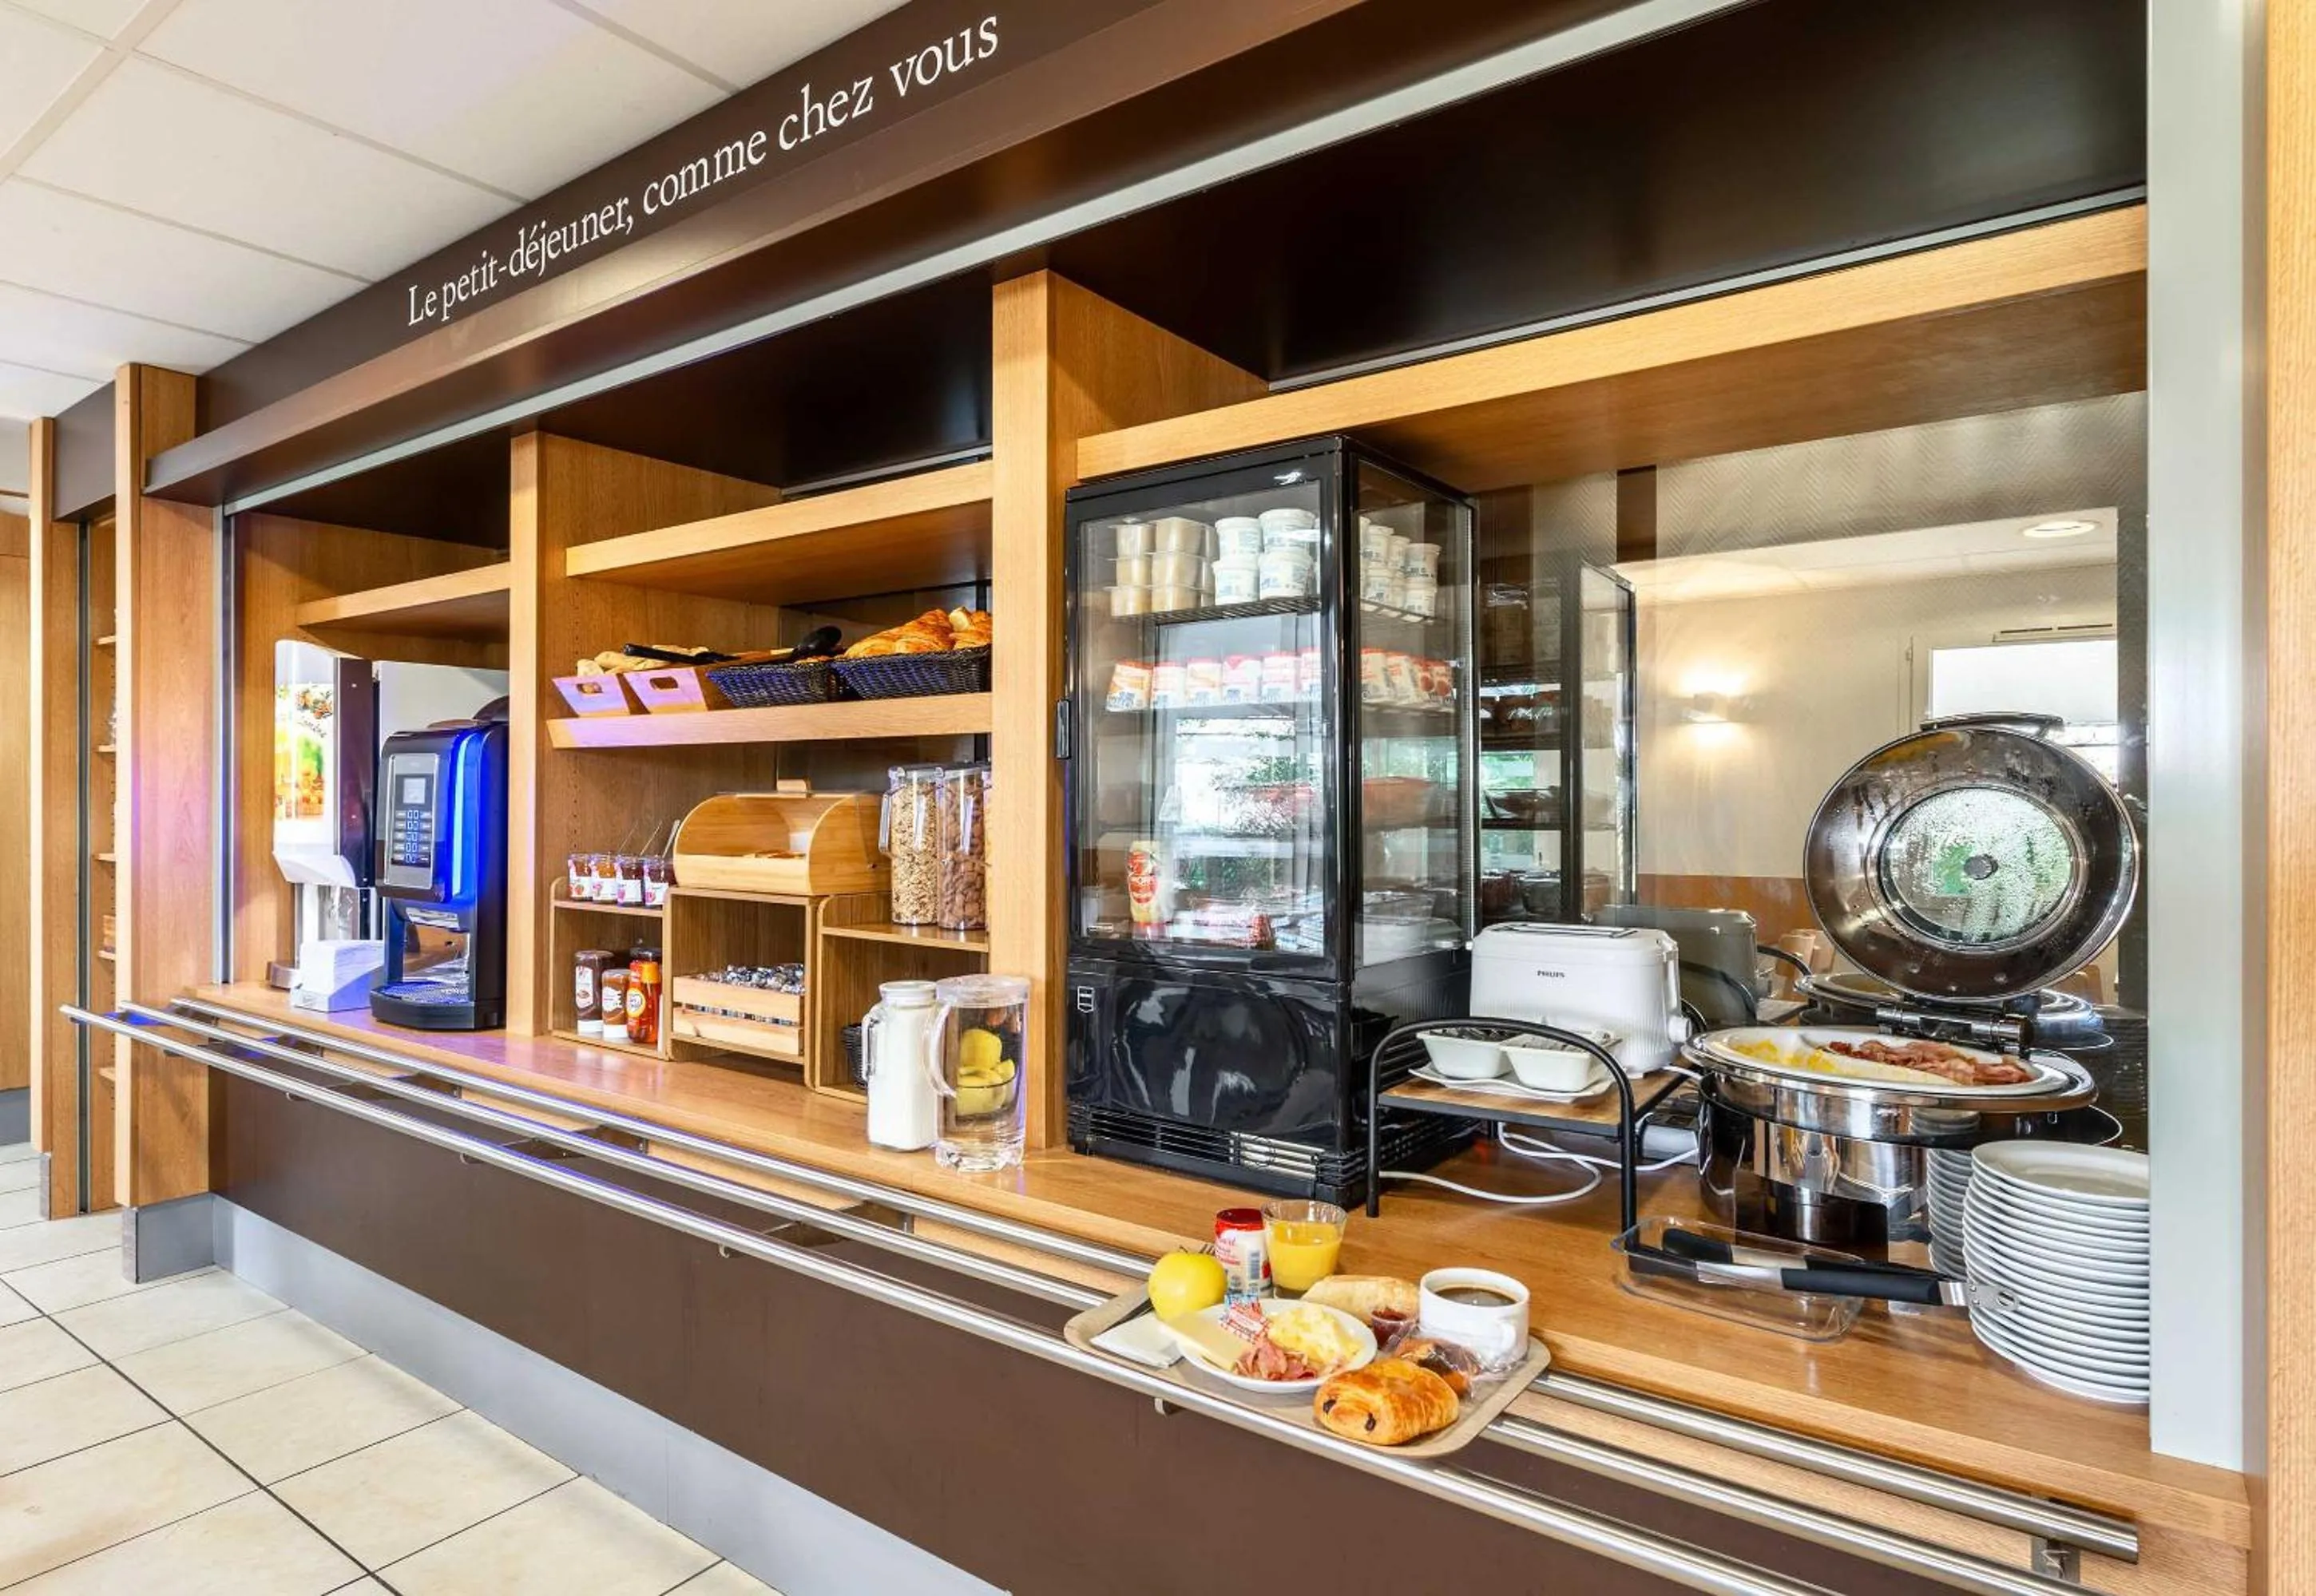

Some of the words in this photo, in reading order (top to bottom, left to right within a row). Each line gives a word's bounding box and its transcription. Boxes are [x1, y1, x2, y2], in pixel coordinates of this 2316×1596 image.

[408, 285, 437, 327] Le
[441, 196, 633, 322] petit-déjeuner,
[643, 130, 767, 215] comme
[779, 76, 874, 151] chez
[889, 16, 998, 97] vous
